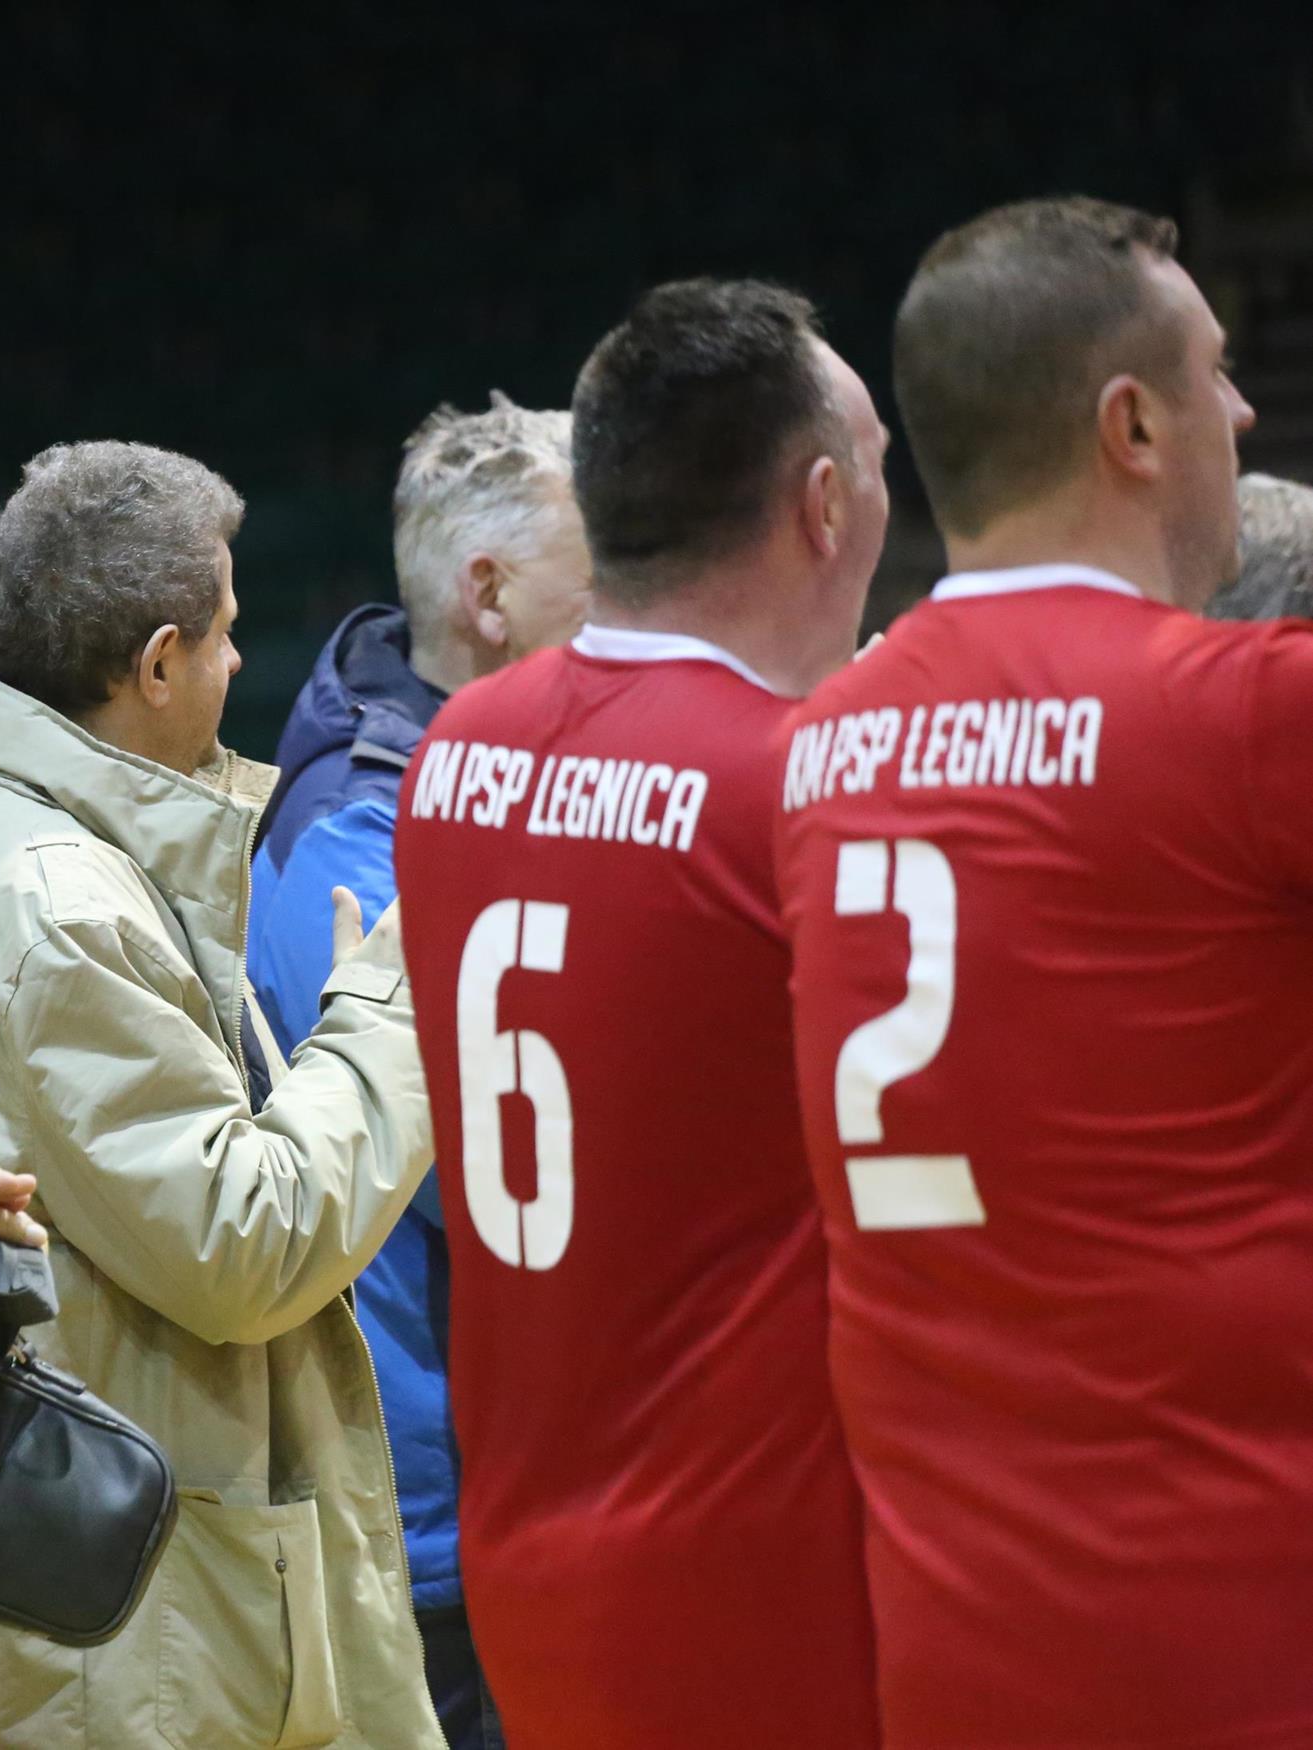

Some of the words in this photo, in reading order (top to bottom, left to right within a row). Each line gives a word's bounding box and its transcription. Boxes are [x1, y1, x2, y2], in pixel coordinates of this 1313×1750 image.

[454, 742, 535, 829] PSP
[526, 755, 708, 852] LEGNICA
[899, 697, 1103, 788] LEGNICA
[457, 899, 574, 1271] 6
[835, 839, 986, 1231] 2
